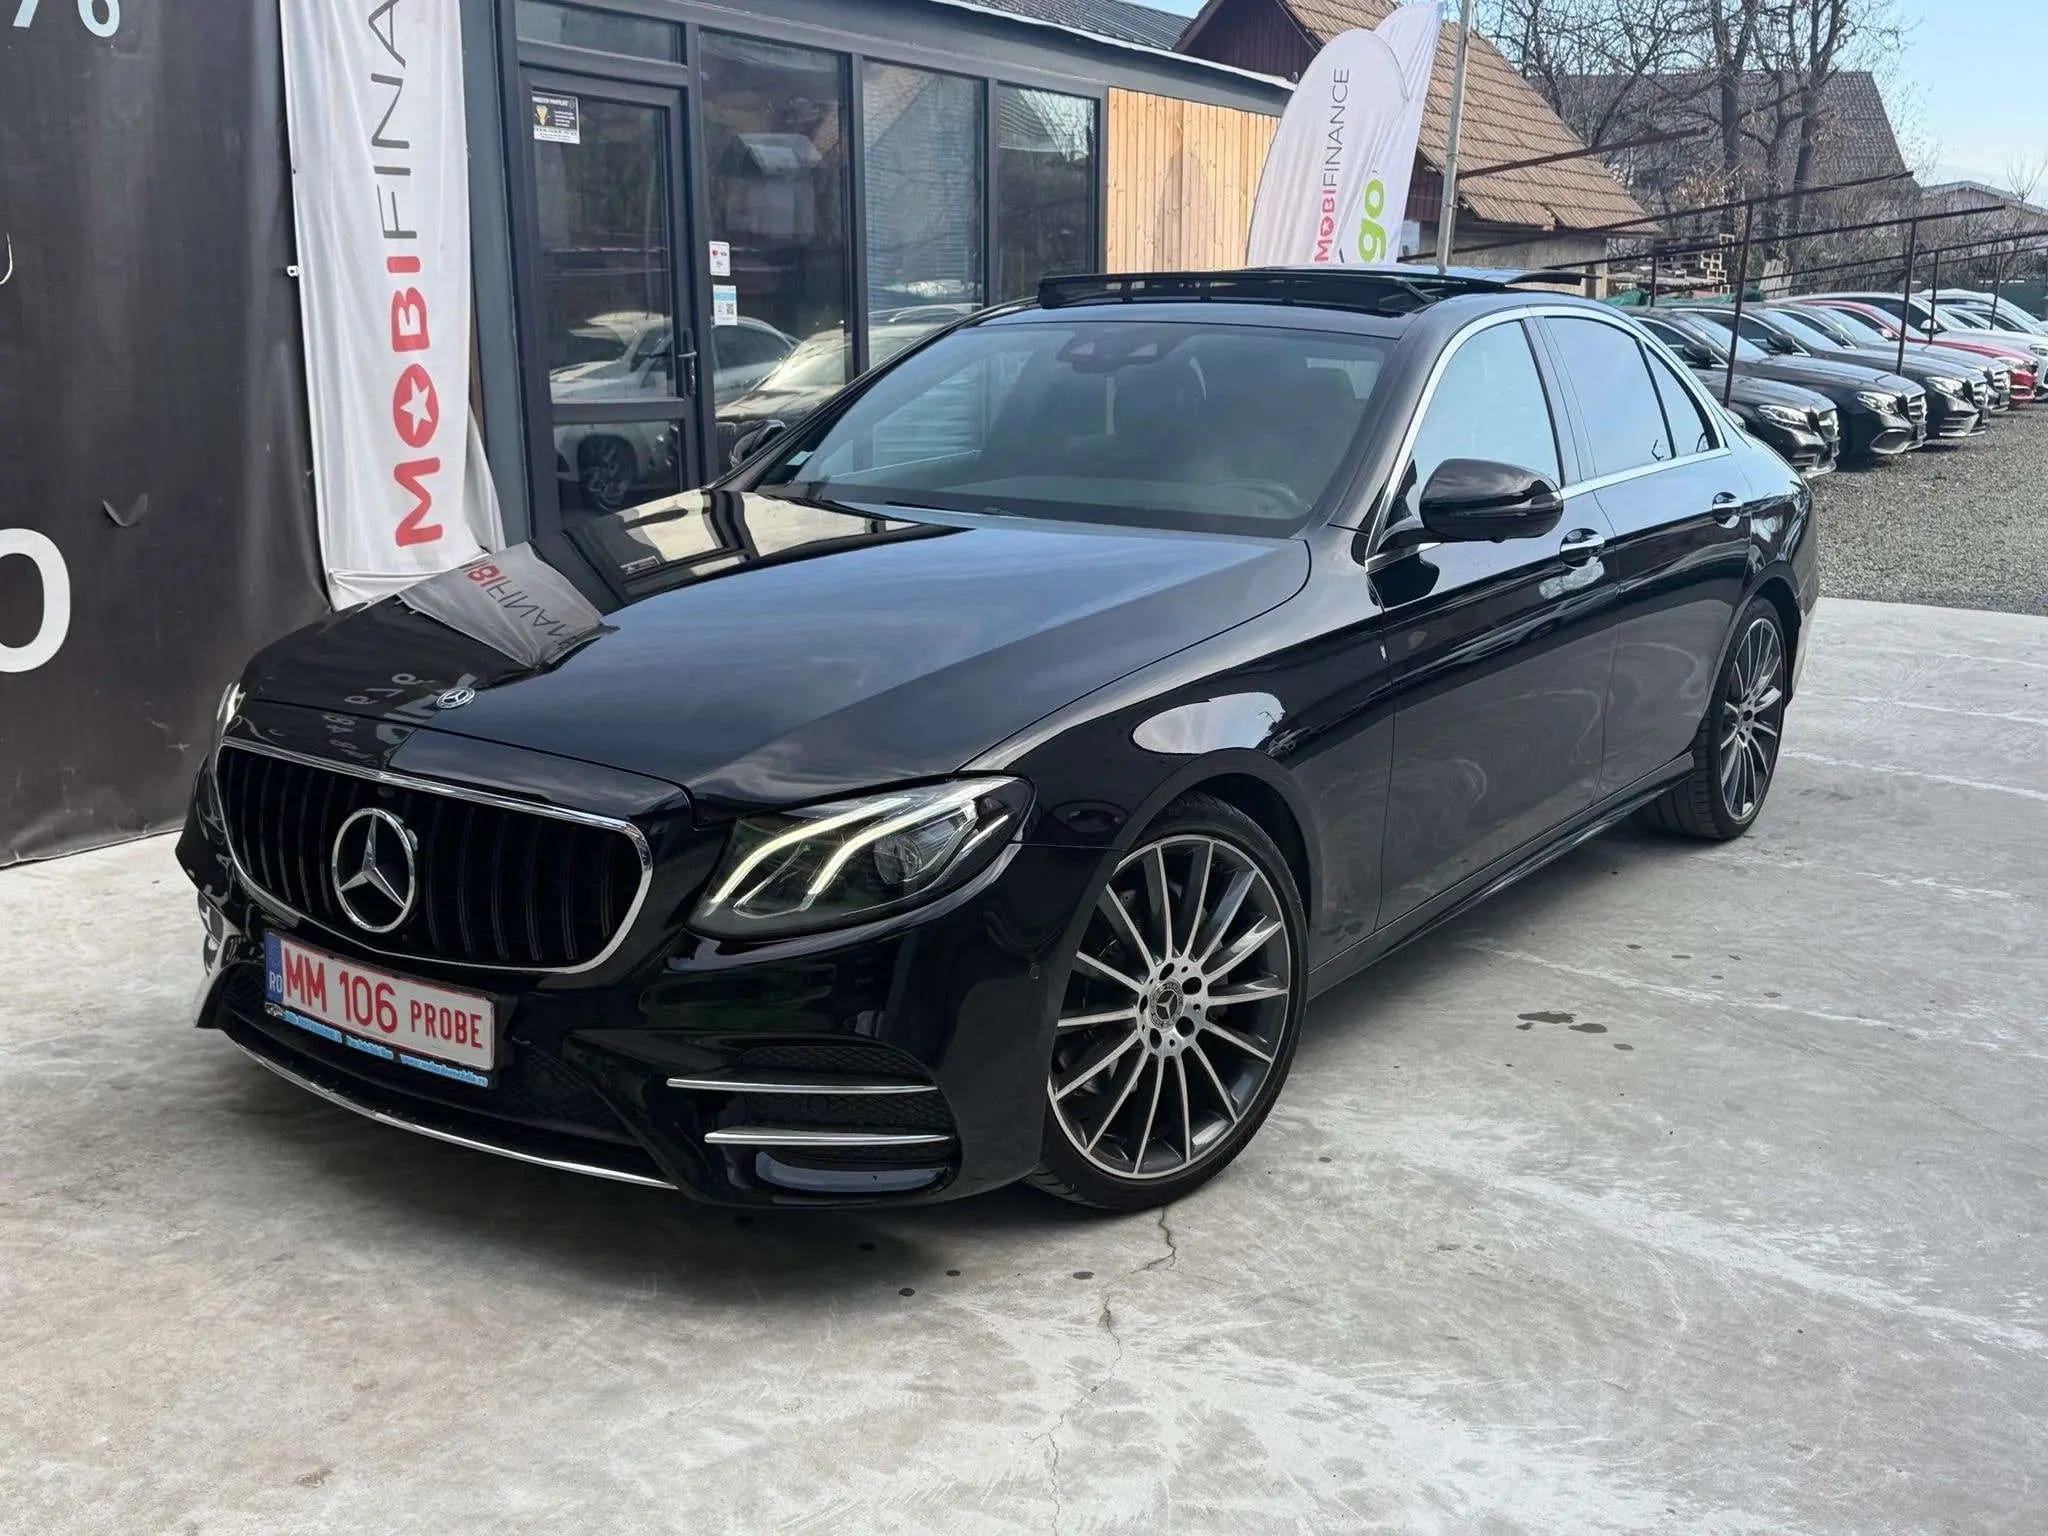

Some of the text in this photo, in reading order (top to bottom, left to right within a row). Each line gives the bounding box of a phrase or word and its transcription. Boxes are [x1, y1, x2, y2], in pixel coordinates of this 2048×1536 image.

[268, 971, 283, 993] RO
[284, 949, 327, 1012] MM
[339, 970, 398, 1033] 106
[410, 1000, 482, 1048] PROBE
